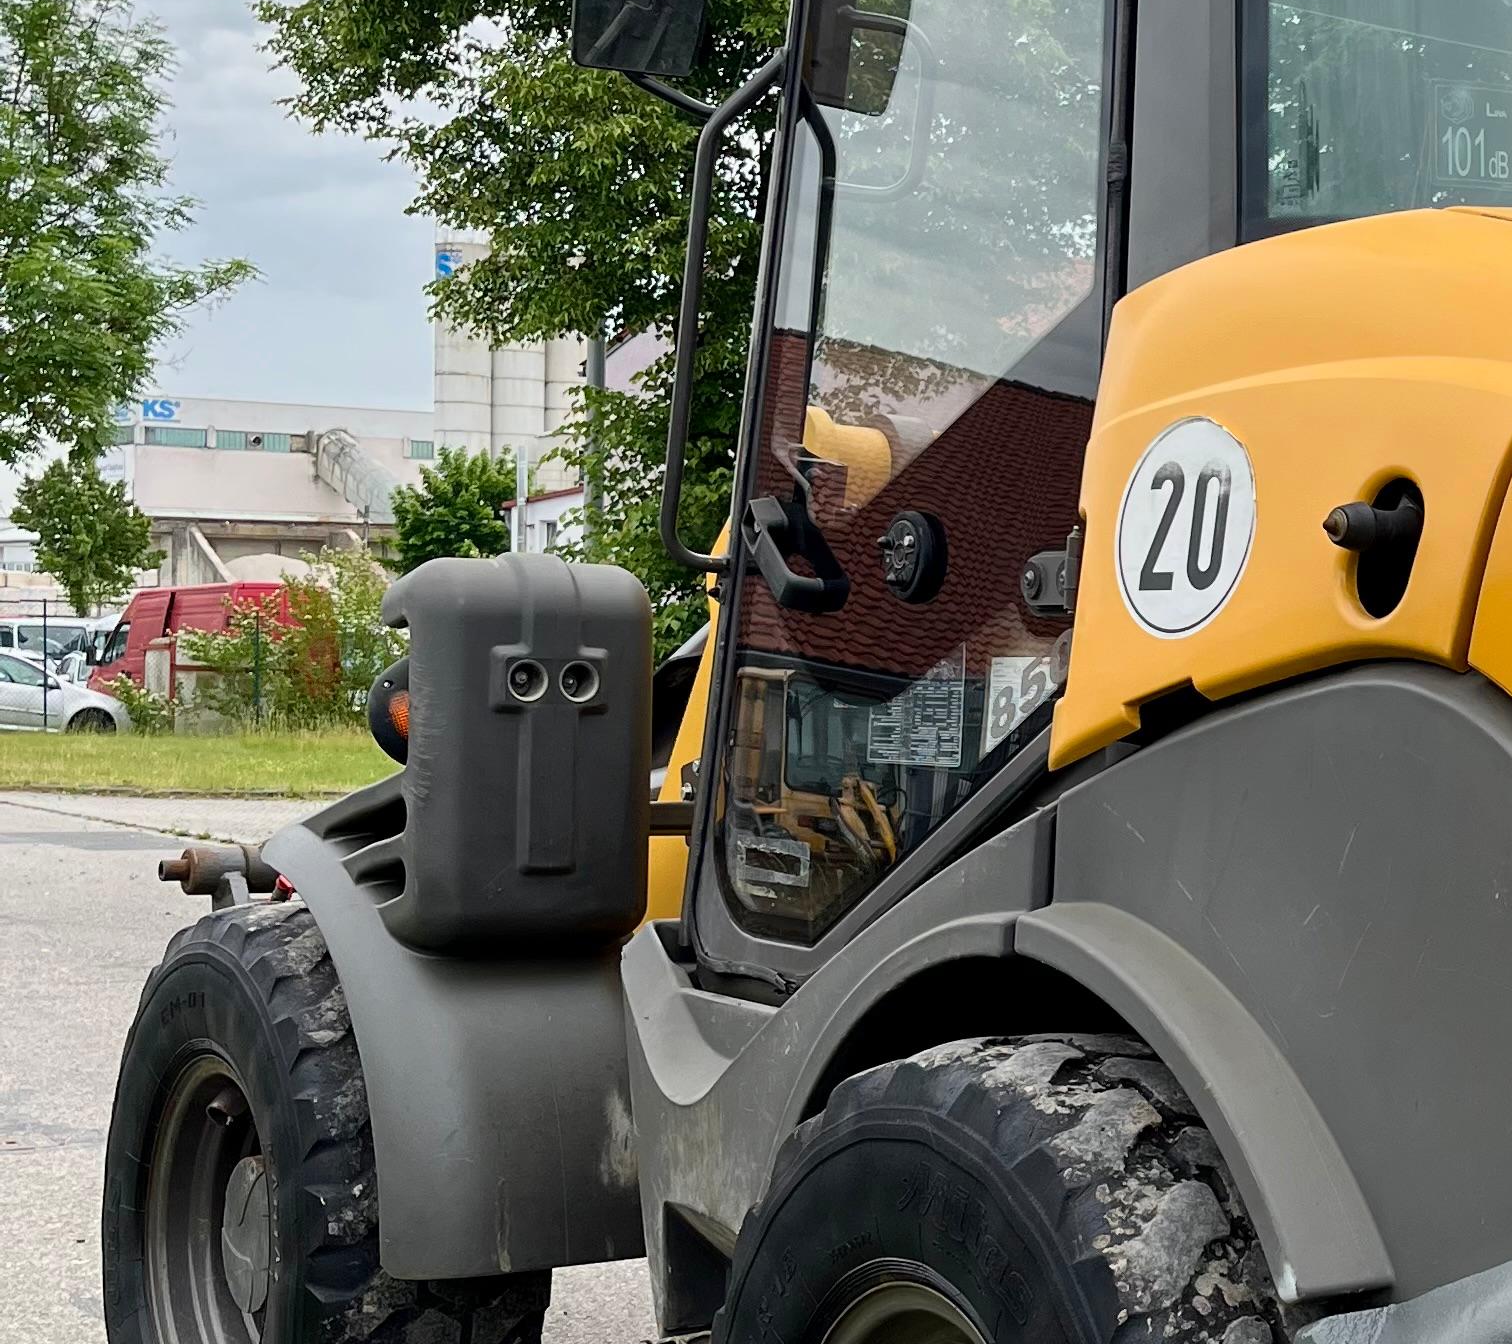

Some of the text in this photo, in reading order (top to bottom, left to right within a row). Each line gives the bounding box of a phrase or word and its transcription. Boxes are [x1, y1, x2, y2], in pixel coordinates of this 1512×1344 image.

[1442, 126, 1510, 179] 101 dB
[1138, 460, 1232, 592] 20
